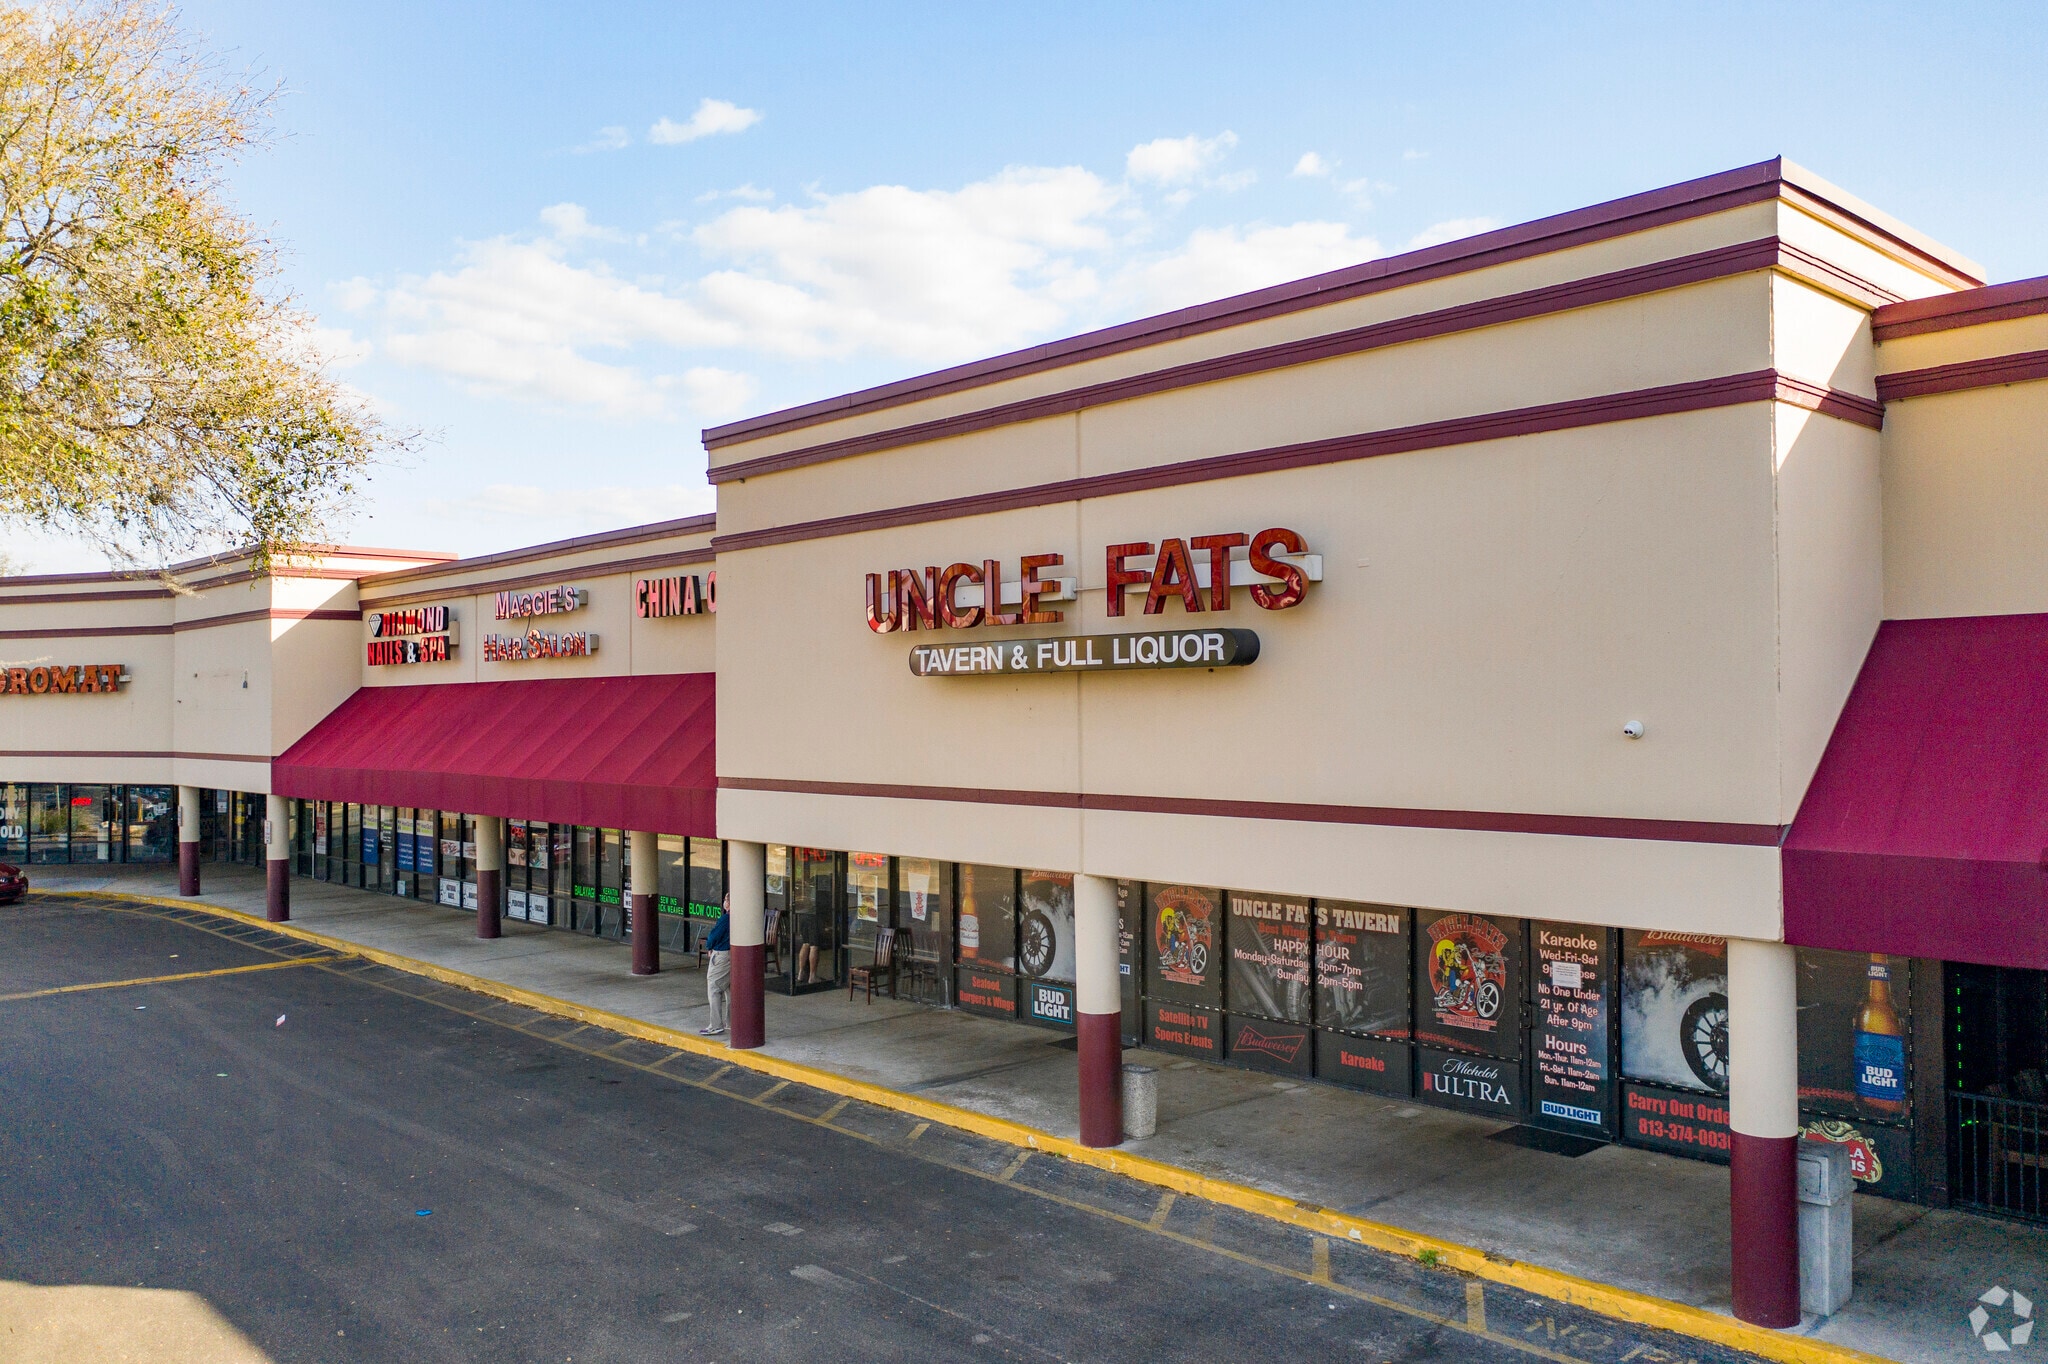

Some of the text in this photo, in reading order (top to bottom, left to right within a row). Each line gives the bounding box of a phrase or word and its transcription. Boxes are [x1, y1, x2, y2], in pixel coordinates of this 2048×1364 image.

[865, 527, 1309, 634] UNCLE FATS
[636, 575, 702, 618] CHINA
[382, 606, 449, 637] DIAMOND
[368, 635, 451, 666] NAILS & SPA
[915, 632, 1225, 673] TAVERN & FULL LIQUOR
[1232, 898, 1282, 921] UNCLE
[1332, 908, 1400, 934] TAVERN
[1427, 914, 1509, 952] UNCLE FATS
[1540, 930, 1598, 951] Karaoke
[1273, 938, 1350, 960] HAPPY HOUR
[1539, 948, 1599, 966] Wed-Fri-Sat
[1234, 948, 1362, 978] Monday-Saturday 4pm-7pm
[1870, 965, 1886, 974] BUD
[1277, 968, 1363, 992] Sunday 2pm-5pm
[1867, 971, 1888, 979] LIGHT
[1039, 988, 1065, 1004] BUD
[1552, 985, 1571, 998] One
[1573, 988, 1601, 1002] Under
[1034, 1001, 1070, 1020] LIGHT
[1159, 1008, 1209, 1030] Satellite TV
[1540, 998, 1551, 1009] 21
[1567, 1001, 1580, 1013] Of
[1581, 1003, 1598, 1018] Age
[1546, 1013, 1593, 1031] After 9pm
[1155, 1025, 1184, 1045] Sports
[1236, 1031, 1299, 1054] Budweiser
[1545, 1034, 1588, 1055] Hours
[1340, 1050, 1385, 1072] Karoake
[1442, 1058, 1499, 1080] Michelob
[1865, 1065, 1894, 1079] BUD
[1433, 1073, 1511, 1105] ULTRA
[1861, 1073, 1898, 1088] LIGHT
[1543, 1103, 1599, 1122] BUD LIGHT
[1628, 1091, 1730, 1125] Carry Out Orde
[1638, 1118, 1731, 1150] 813-374-003
